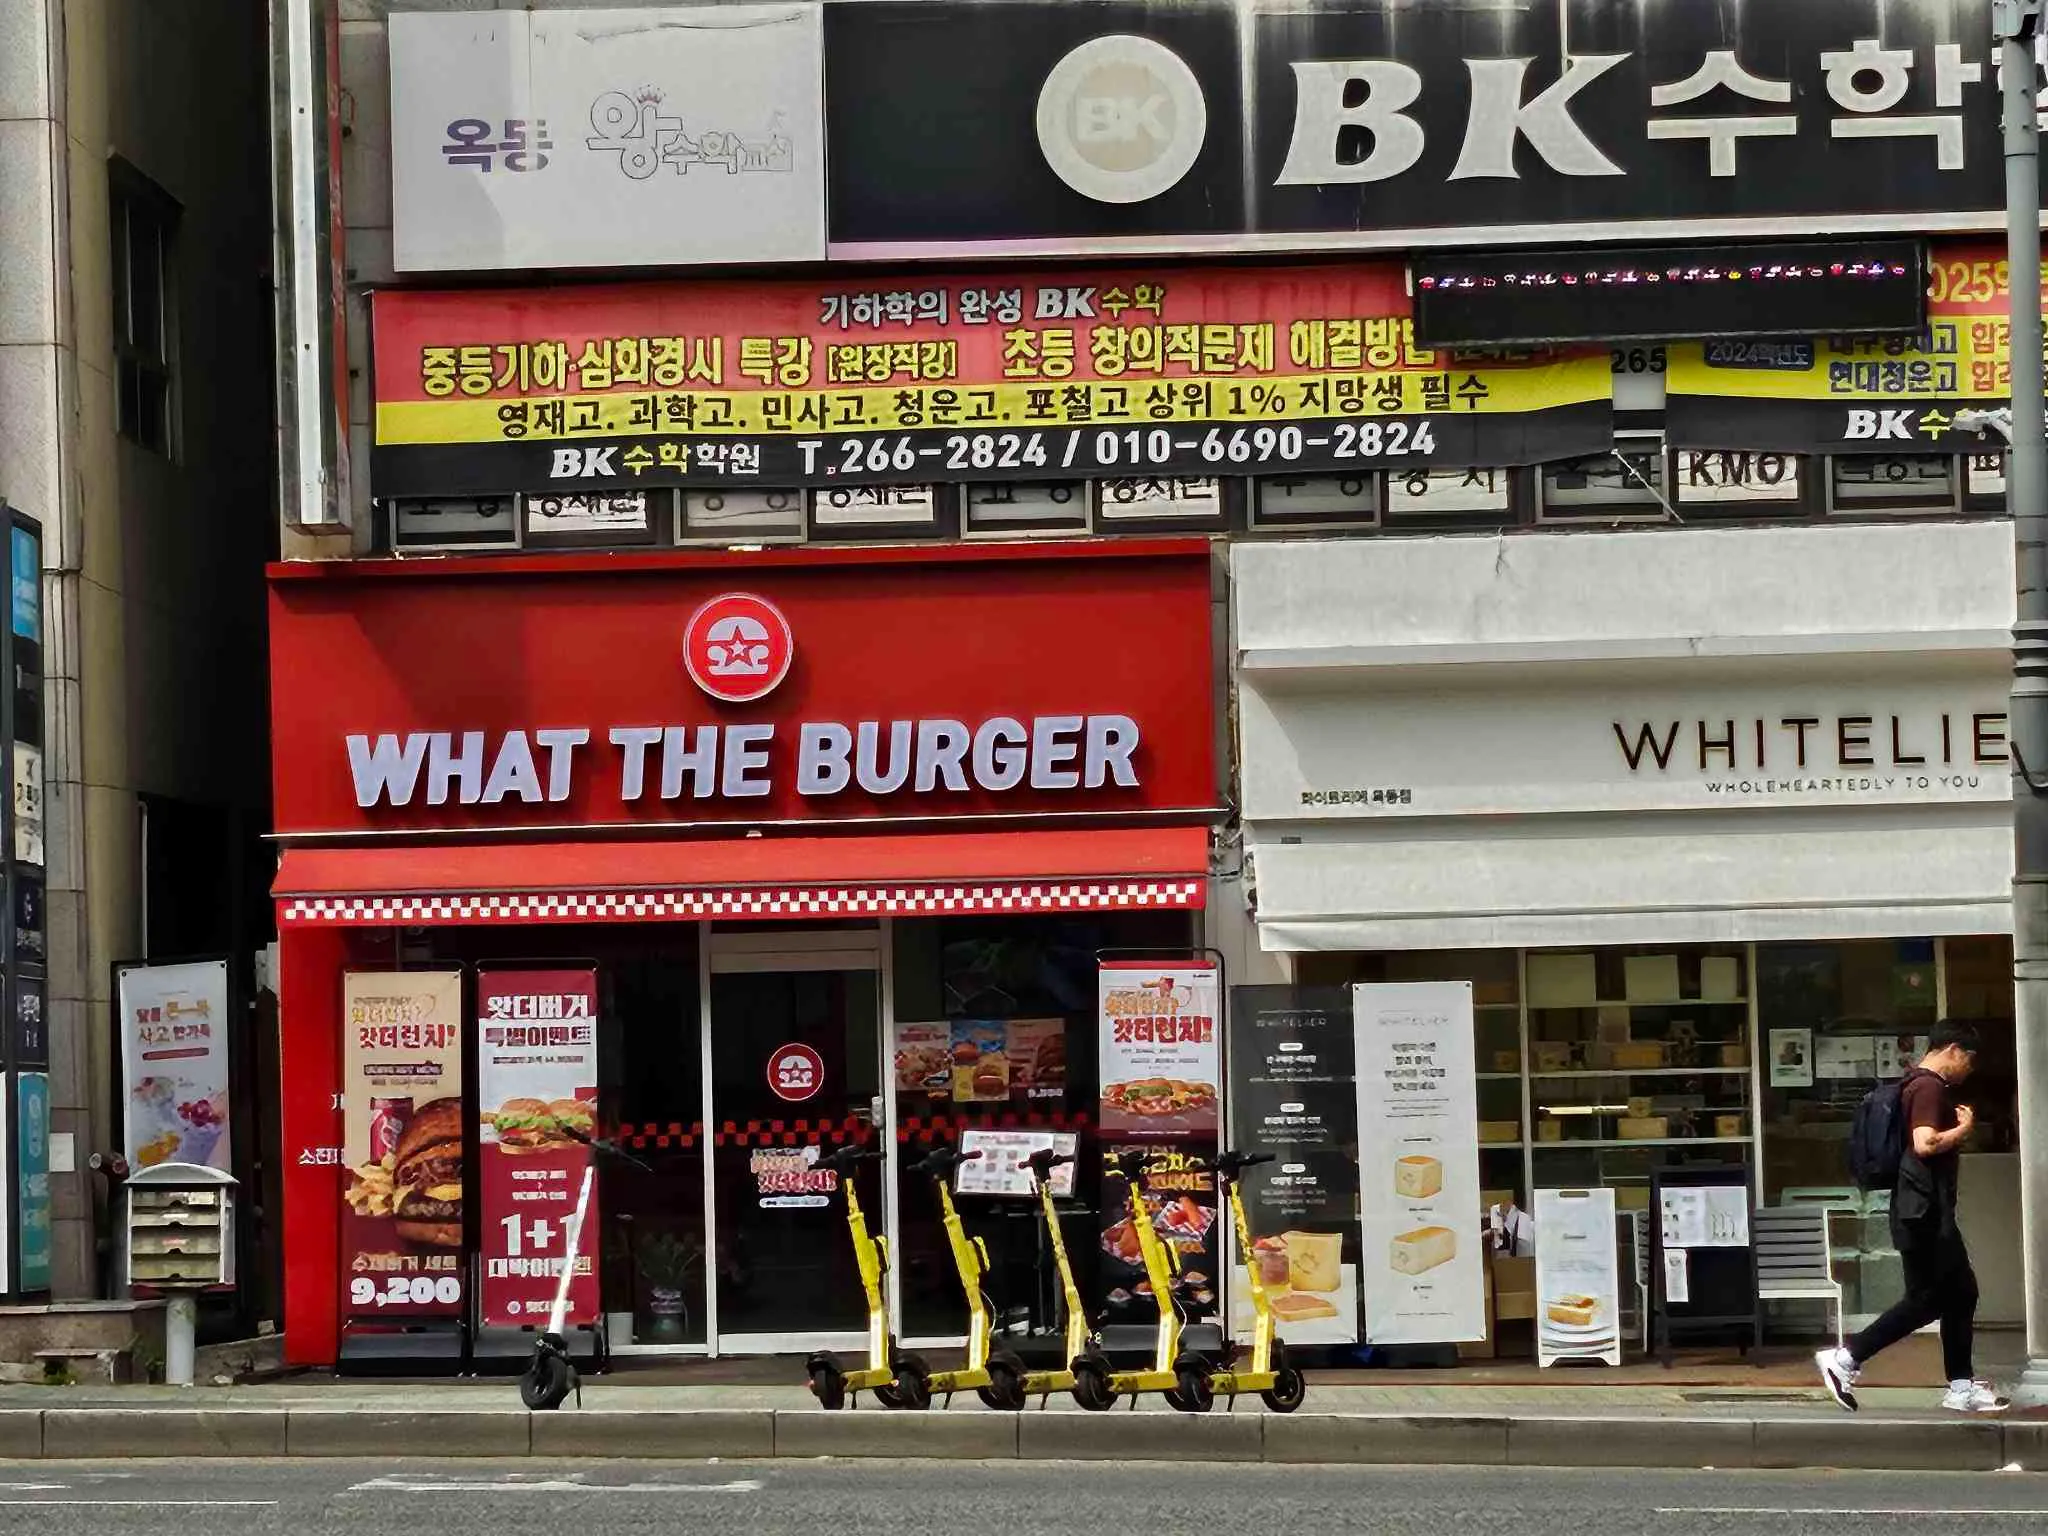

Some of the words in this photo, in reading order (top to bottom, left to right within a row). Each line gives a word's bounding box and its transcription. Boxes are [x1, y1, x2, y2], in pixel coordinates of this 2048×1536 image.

[1074, 96, 1168, 143] BK
[1273, 42, 2048, 188] BK수학
[820, 290, 950, 330] 기하학의
[960, 289, 1023, 325] 완성
[739, 334, 814, 385] 특강
[827, 340, 957, 384] [원장직강]
[1003, 328, 1076, 379] 초등
[1090, 322, 1275, 377] 창의적문제
[1611, 347, 1667, 374] 265
[497, 400, 615, 439] 영재고.
[628, 396, 747, 433] 과학고.
[762, 392, 879, 431] 민사고.
[892, 388, 1010, 424] 청운고.
[1025, 386, 1130, 420] 포철고
[1145, 383, 1212, 418] 상위
[1229, 384, 1285, 414] 1%
[1300, 376, 1405, 414] 지망생
[1421, 375, 1489, 411] 필수
[1096, 421, 1436, 465] 010-6690-2824
[346, 728, 590, 807] WHAT
[608, 724, 775, 801] THE
[797, 714, 1141, 795] BURGER
[1705, 778, 1895, 793] WHOLEHEARTEDLY
[1906, 776, 1930, 790] TO
[1939, 775, 1979, 789] YOU
[350, 1276, 461, 1308] 9,200
